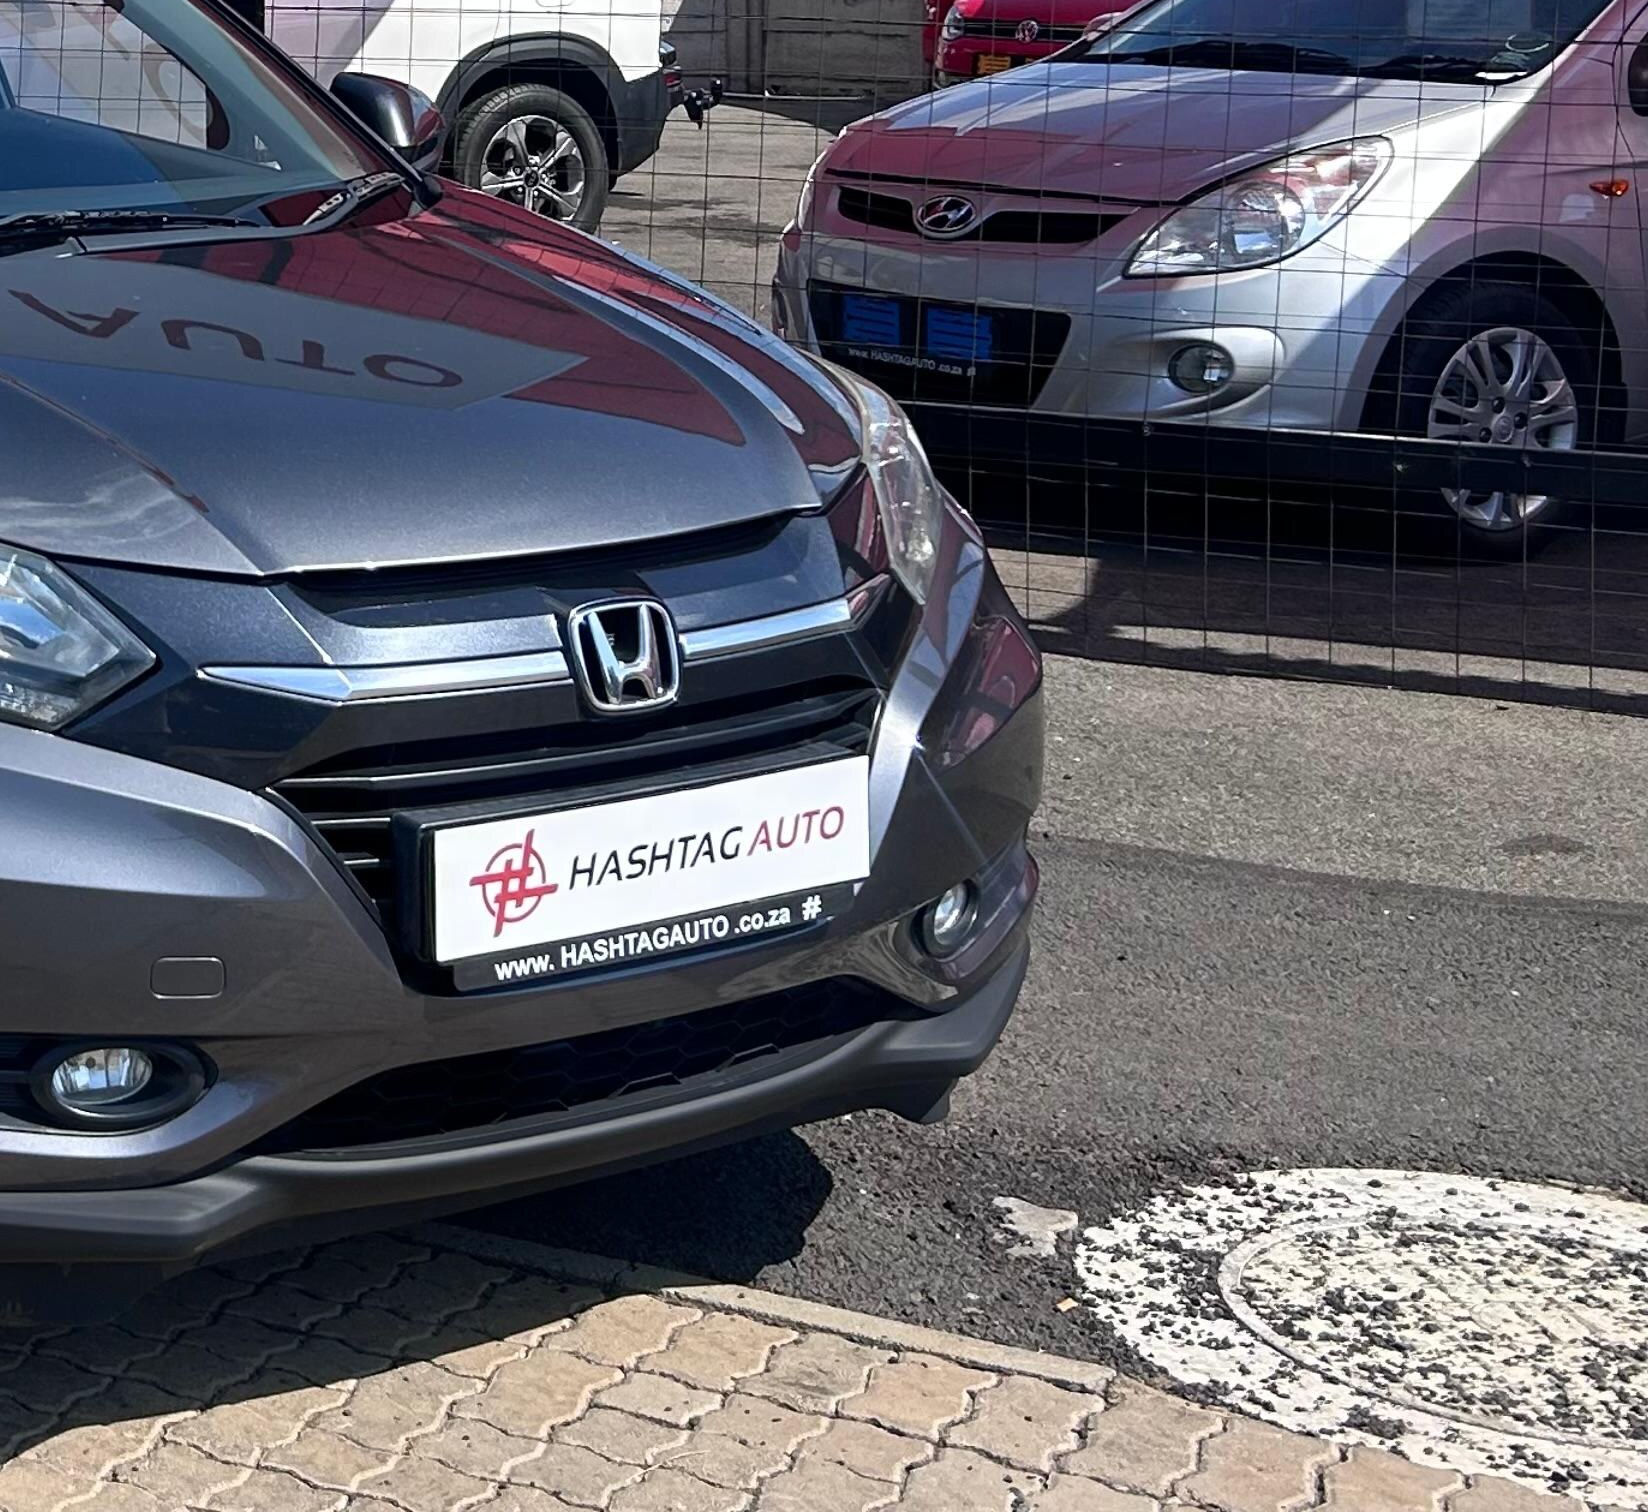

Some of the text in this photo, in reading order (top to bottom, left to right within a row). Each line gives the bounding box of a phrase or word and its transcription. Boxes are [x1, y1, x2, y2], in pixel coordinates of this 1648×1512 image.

[569, 806, 844, 890] HASHTAG AUTO
[494, 954, 555, 981] www.
[560, 914, 730, 969] HASHTAGAUTO
[733, 906, 791, 936] .co.za
